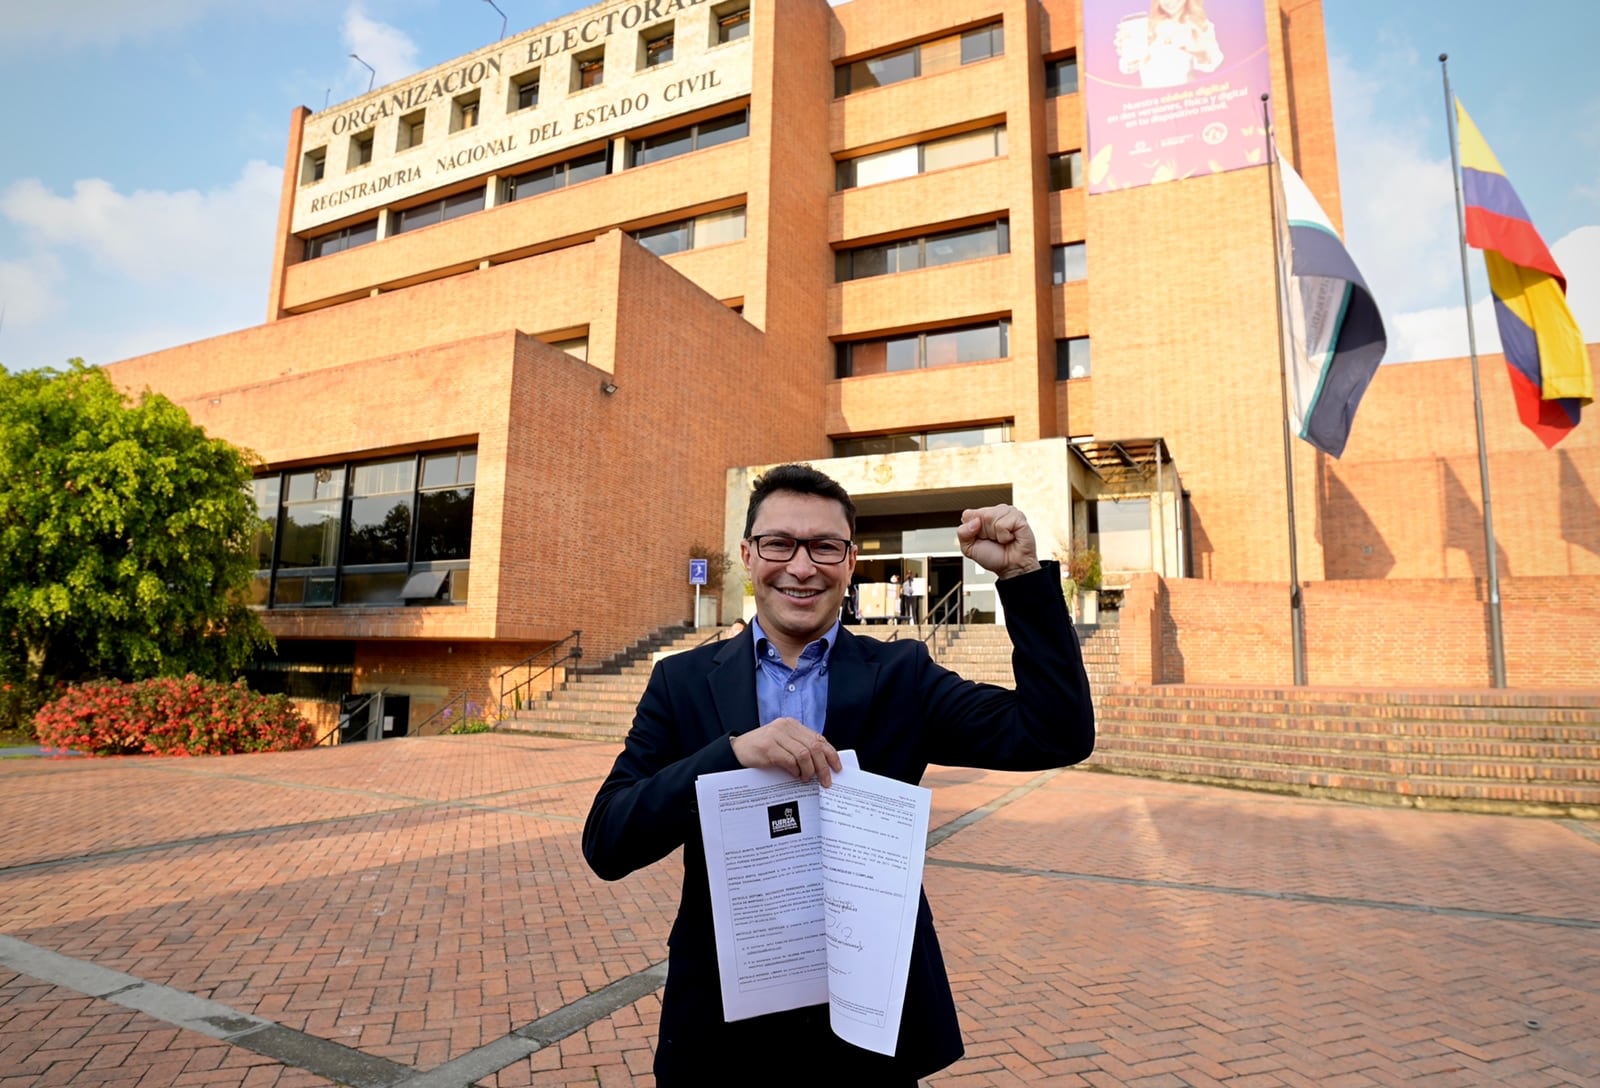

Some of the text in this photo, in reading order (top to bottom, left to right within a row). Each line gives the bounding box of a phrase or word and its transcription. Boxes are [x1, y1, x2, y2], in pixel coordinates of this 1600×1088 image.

[332, 0, 703, 135] ORGANIZACION ELECTORA
[310, 70, 722, 213] REGISTRADURIA NACIONAL DEL ESTADO CIVIL
